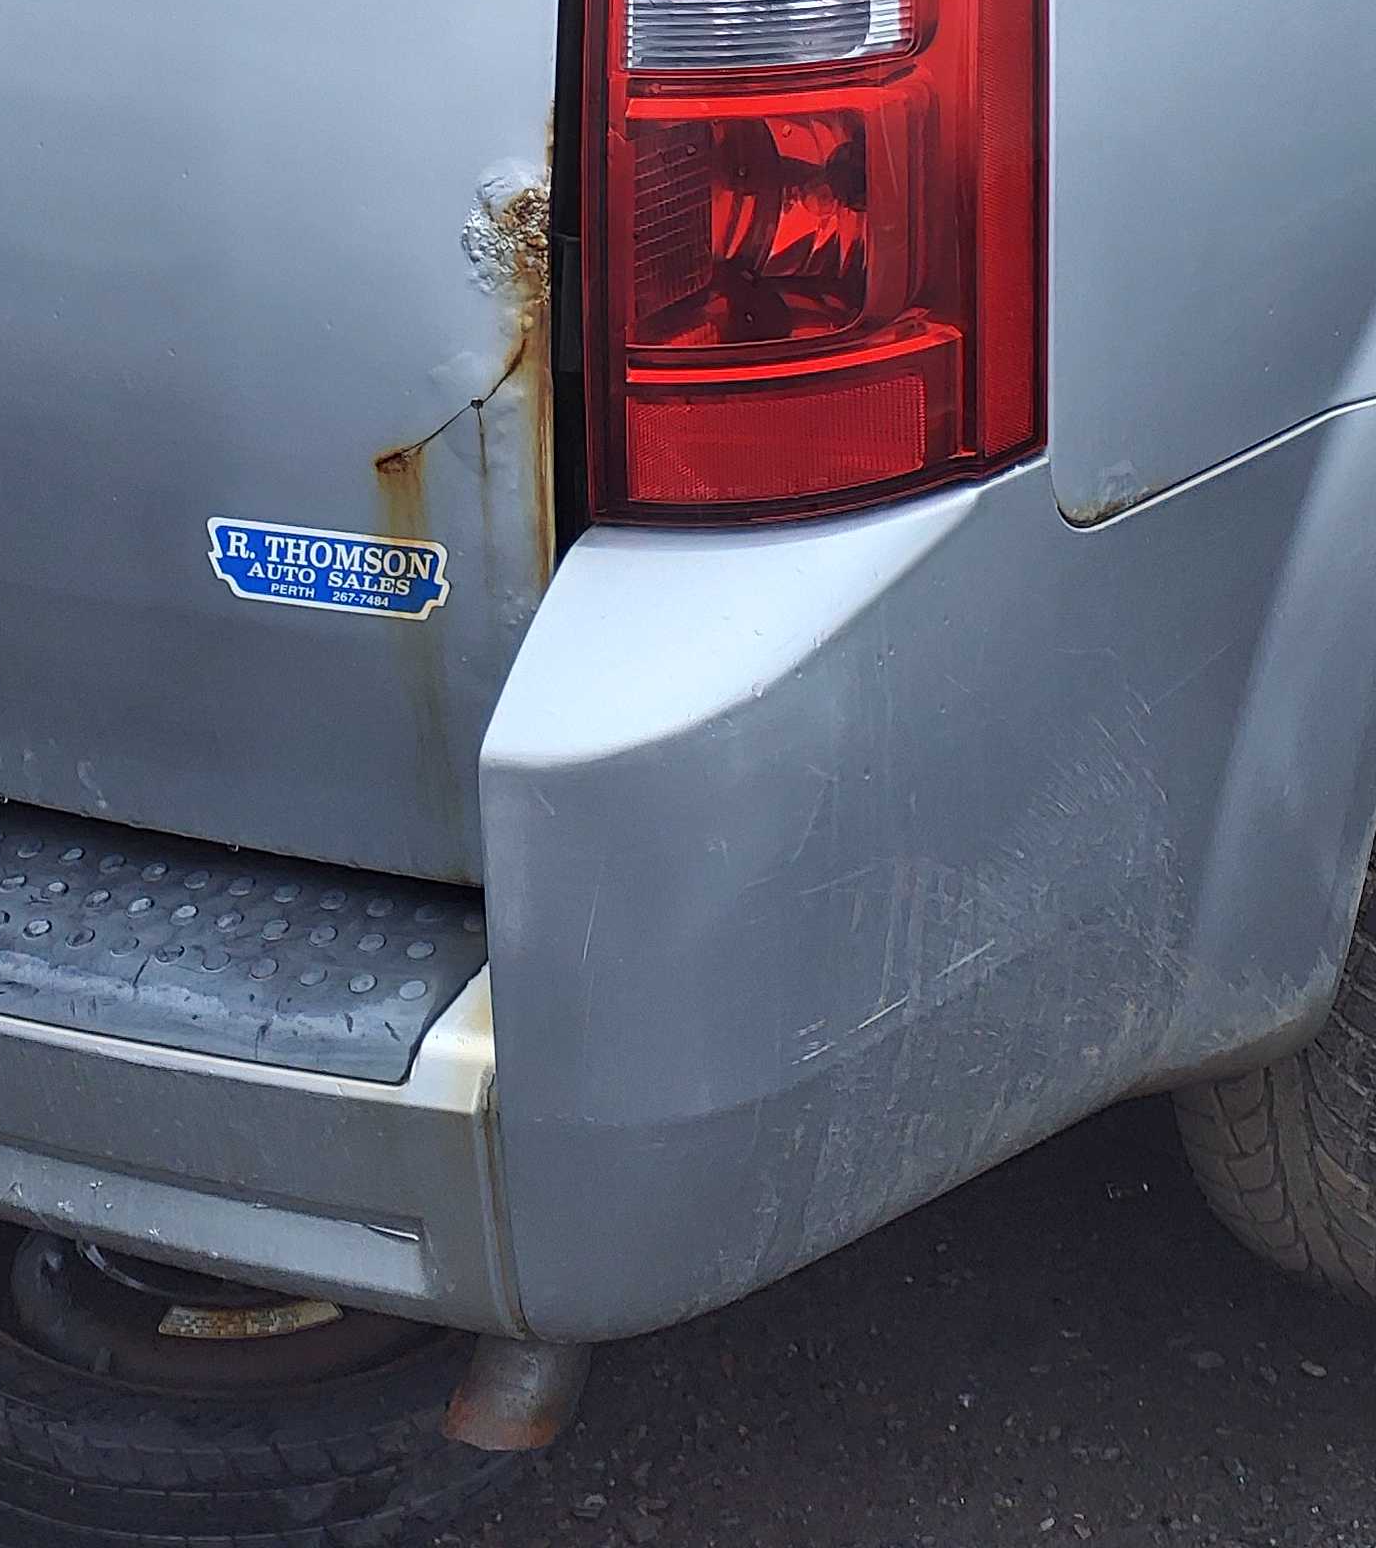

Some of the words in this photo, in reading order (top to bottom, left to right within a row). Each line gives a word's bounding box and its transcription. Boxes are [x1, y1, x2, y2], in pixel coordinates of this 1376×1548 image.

[226, 530, 256, 560] R.
[264, 535, 434, 580] THOMSON
[247, 562, 317, 585] AUTO
[327, 571, 412, 596] SALES
[270, 582, 316, 599] PERTH
[331, 590, 390, 608] 267-7484
